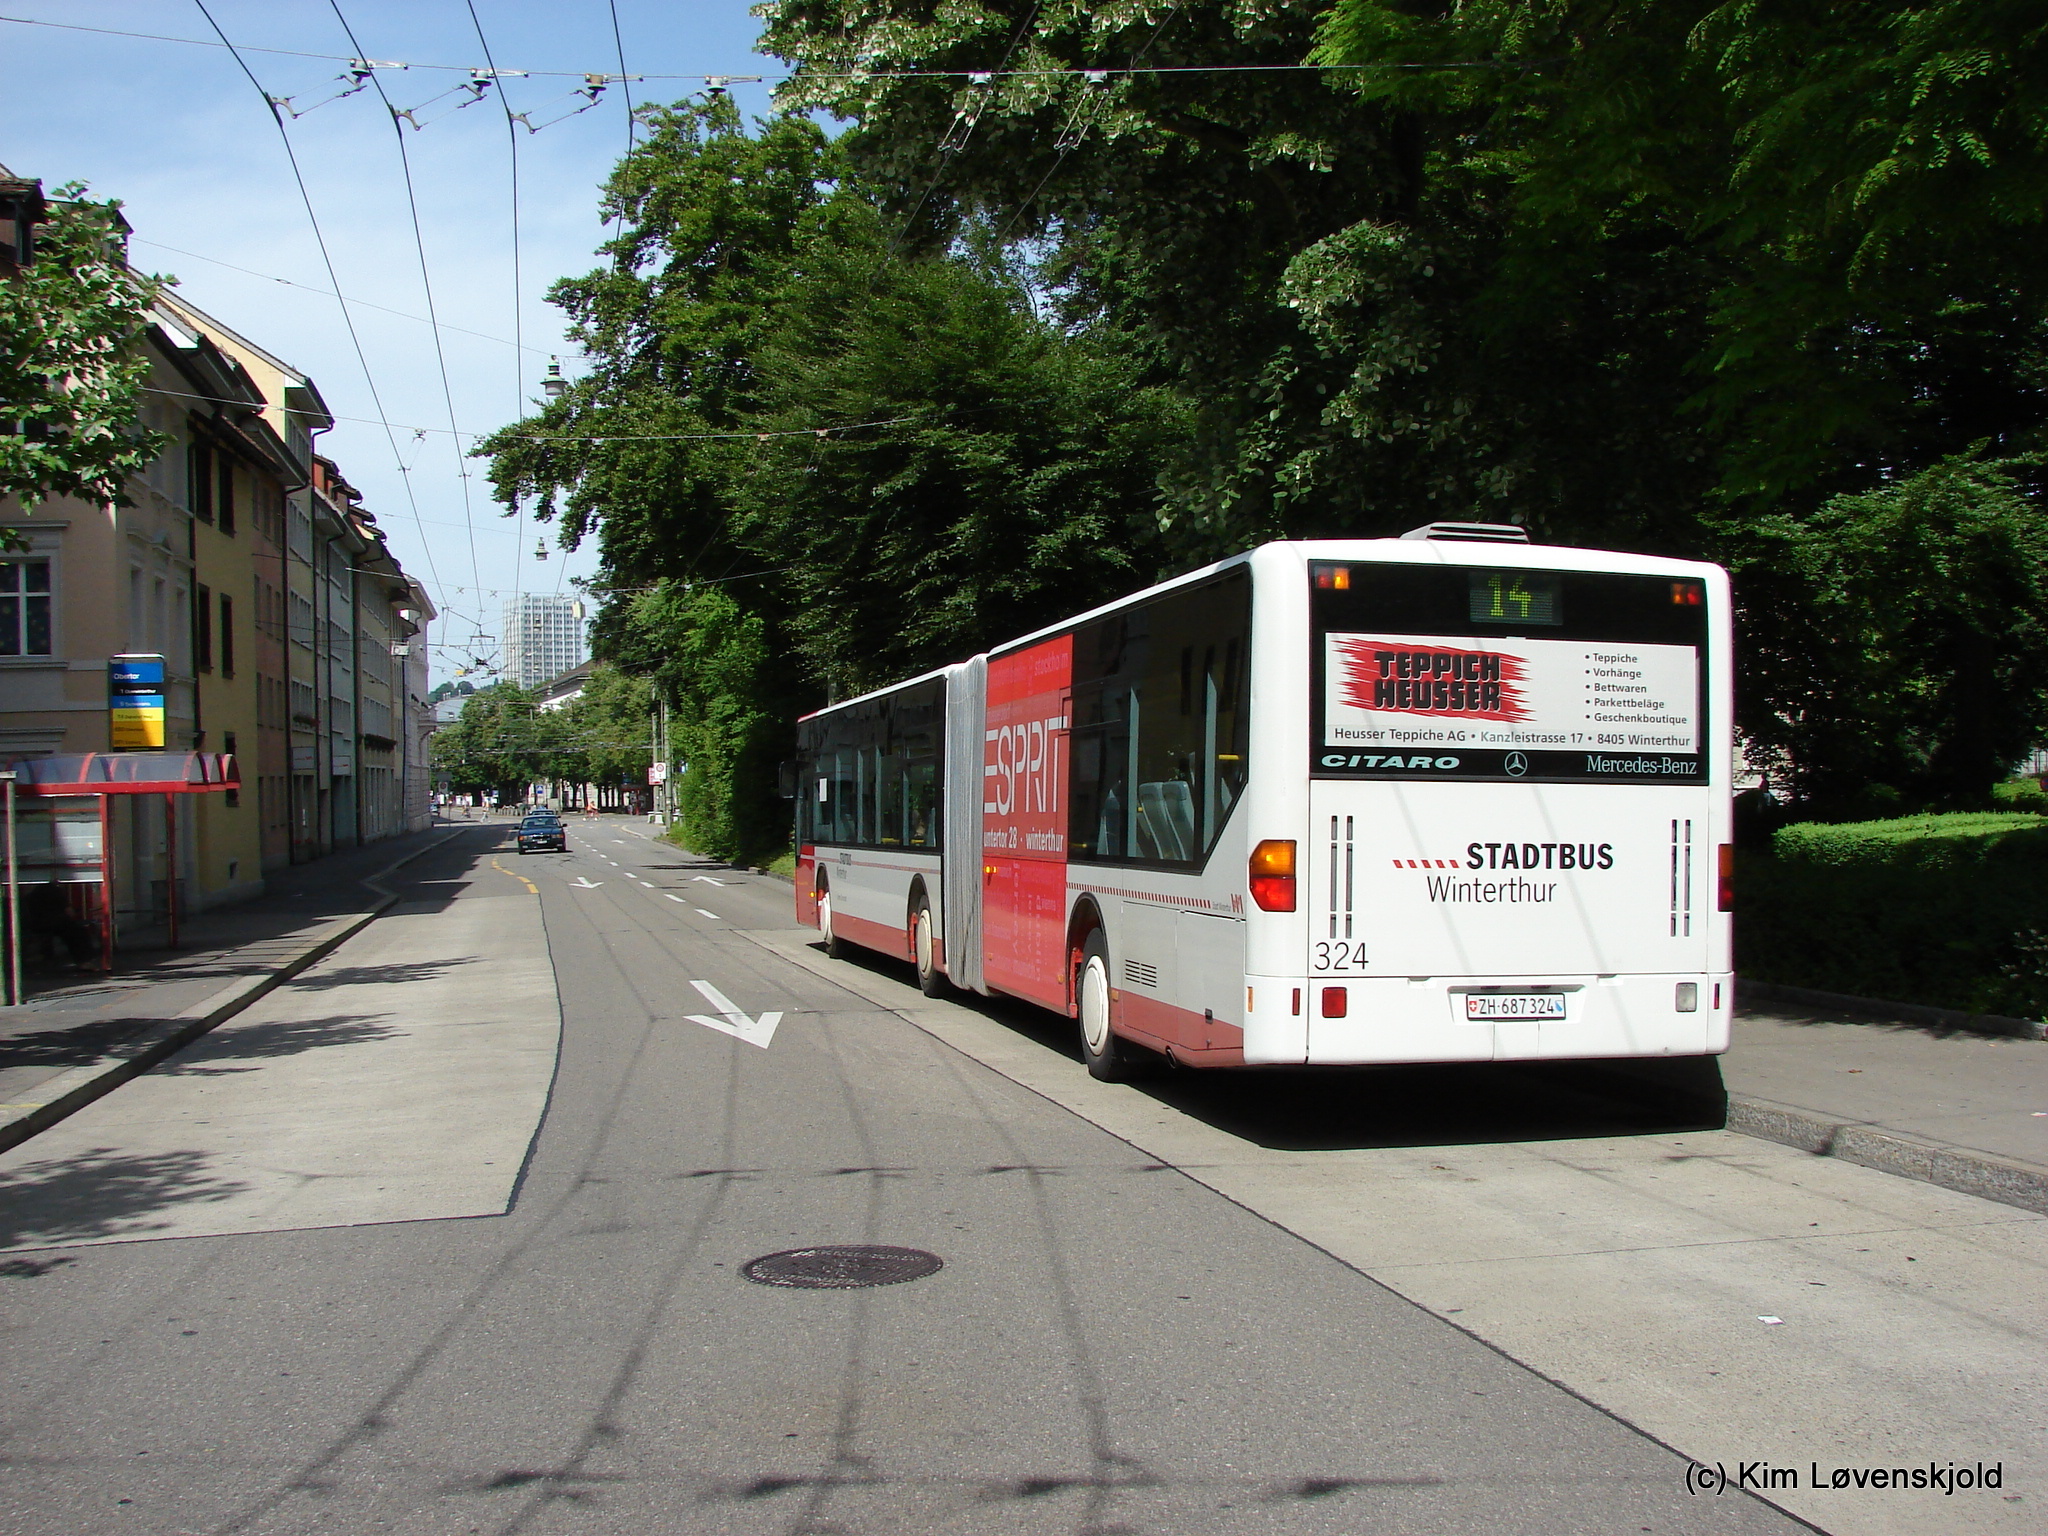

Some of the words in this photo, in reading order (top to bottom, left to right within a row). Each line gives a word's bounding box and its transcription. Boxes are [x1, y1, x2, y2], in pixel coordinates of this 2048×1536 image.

[1488, 574, 1532, 618] 14
[1374, 651, 1501, 682] TEPPICH
[1593, 653, 1638, 664] Teppiche
[1593, 668, 1642, 680] Vorhänge
[1374, 679, 1501, 712] HEUSSER
[1594, 683, 1647, 693] Bettwaren
[1594, 698, 1665, 710] Parkettbeläge
[1594, 713, 1687, 726] Geschenkboutique
[1334, 728, 1385, 740] Heusser
[1389, 729, 1444, 743] Teppiche
[1446, 731, 1466, 742] AG
[1480, 731, 1566, 744] Kanzleistrasse
[1570, 733, 1583, 744] 17
[1597, 734, 1625, 745] 8405
[1628, 735, 1690, 747] Winterthur
[984, 716, 1068, 816] ESPRIT
[1321, 754, 1460, 769] CITARO
[1586, 755, 1697, 775] Mercedes-Benz
[984, 828, 1008, 848] untertor
[1008, 826, 1018, 849] 28
[1026, 827, 1064, 852] winterthur
[1466, 843, 1613, 870] STADTBUS
[1427, 875, 1557, 903] Winterthur
[1314, 942, 1369, 970] 324
